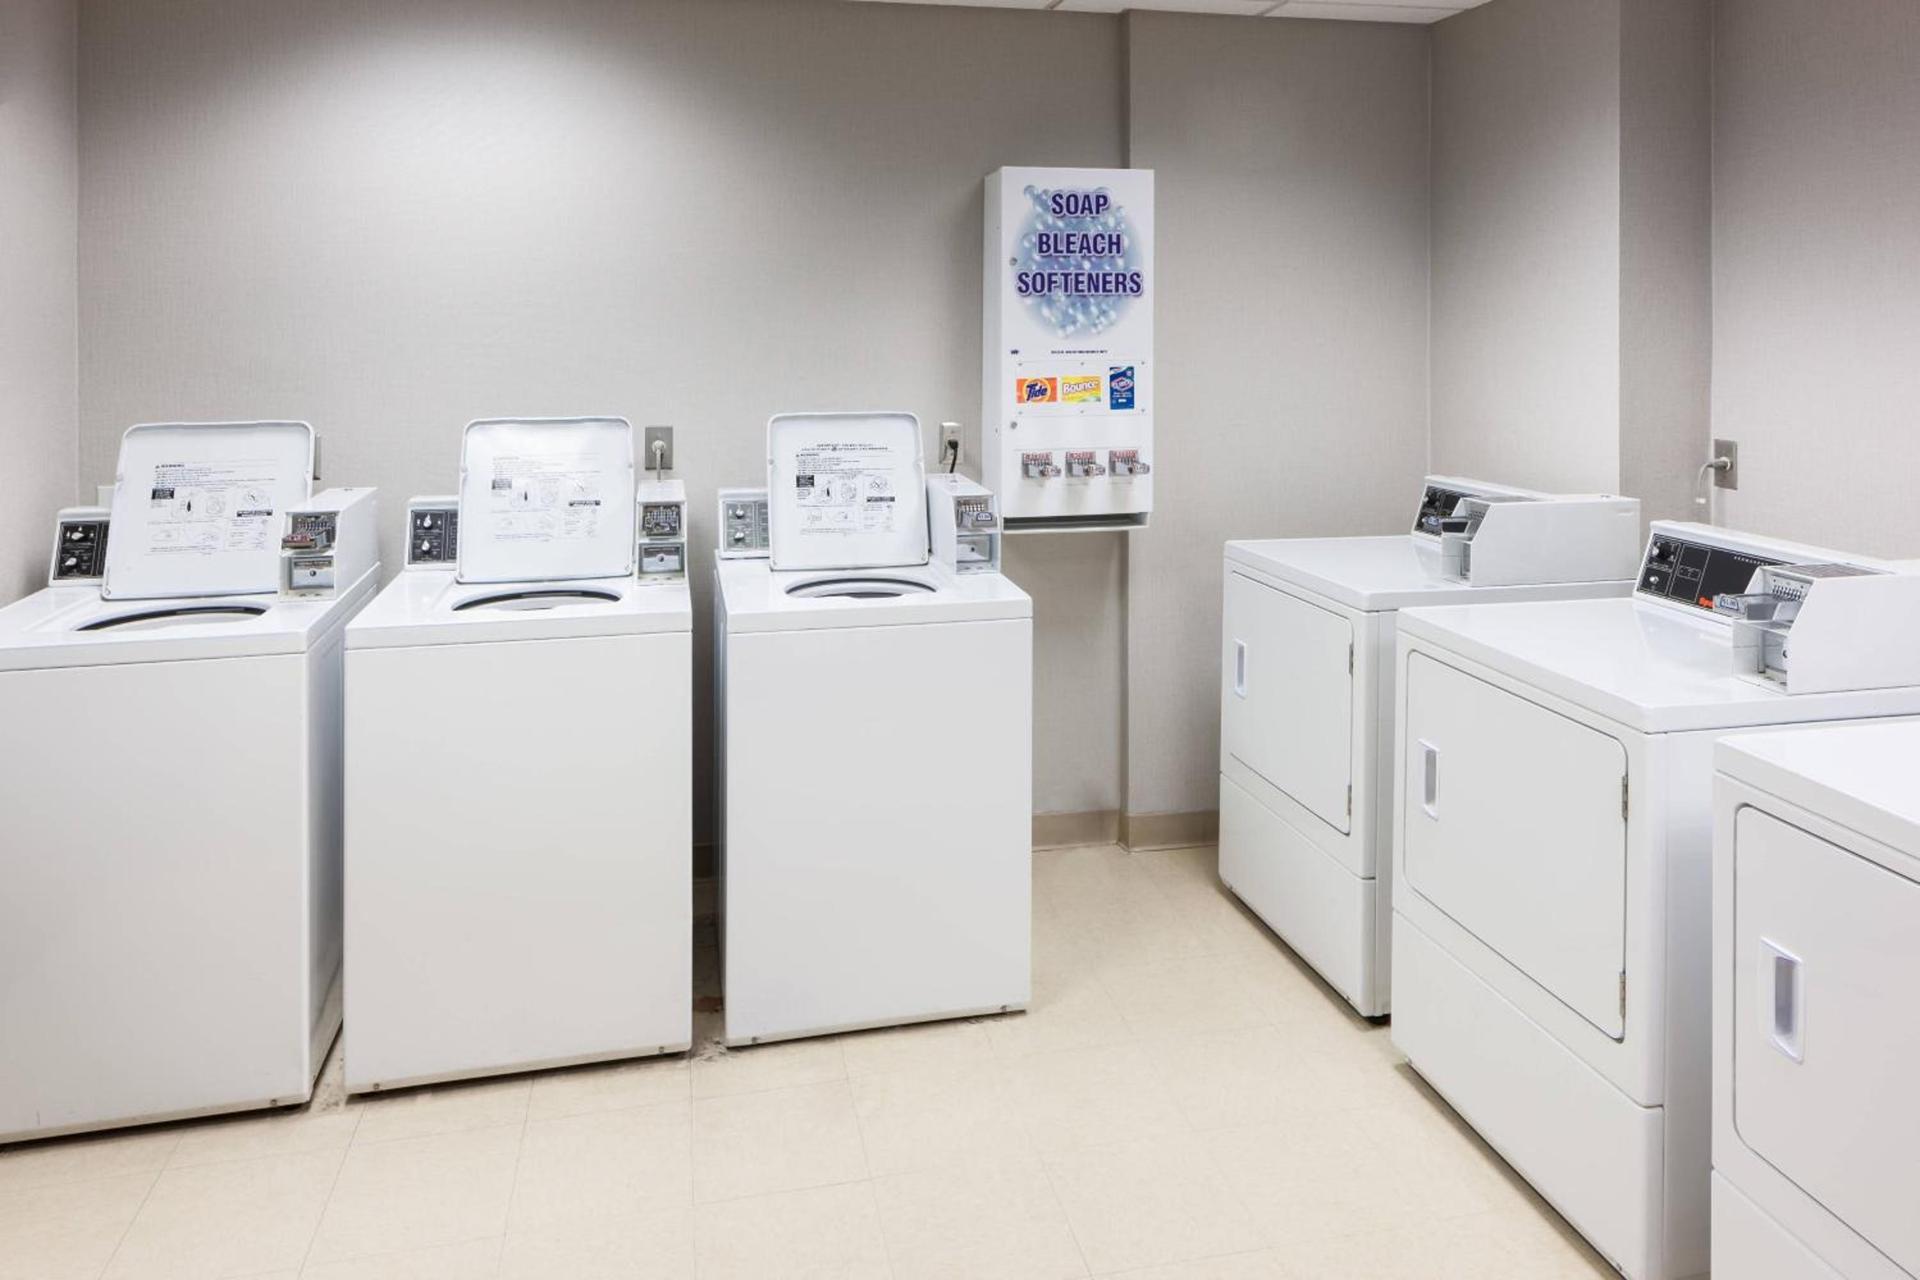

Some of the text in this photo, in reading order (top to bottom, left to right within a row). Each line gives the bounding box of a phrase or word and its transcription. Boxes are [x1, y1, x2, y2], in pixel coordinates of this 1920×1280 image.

[1051, 193, 1109, 216] SOAP
[1037, 232, 1122, 255] BLEACH
[1017, 271, 1142, 294] SOFTENERS
[1026, 382, 1048, 402] Tide
